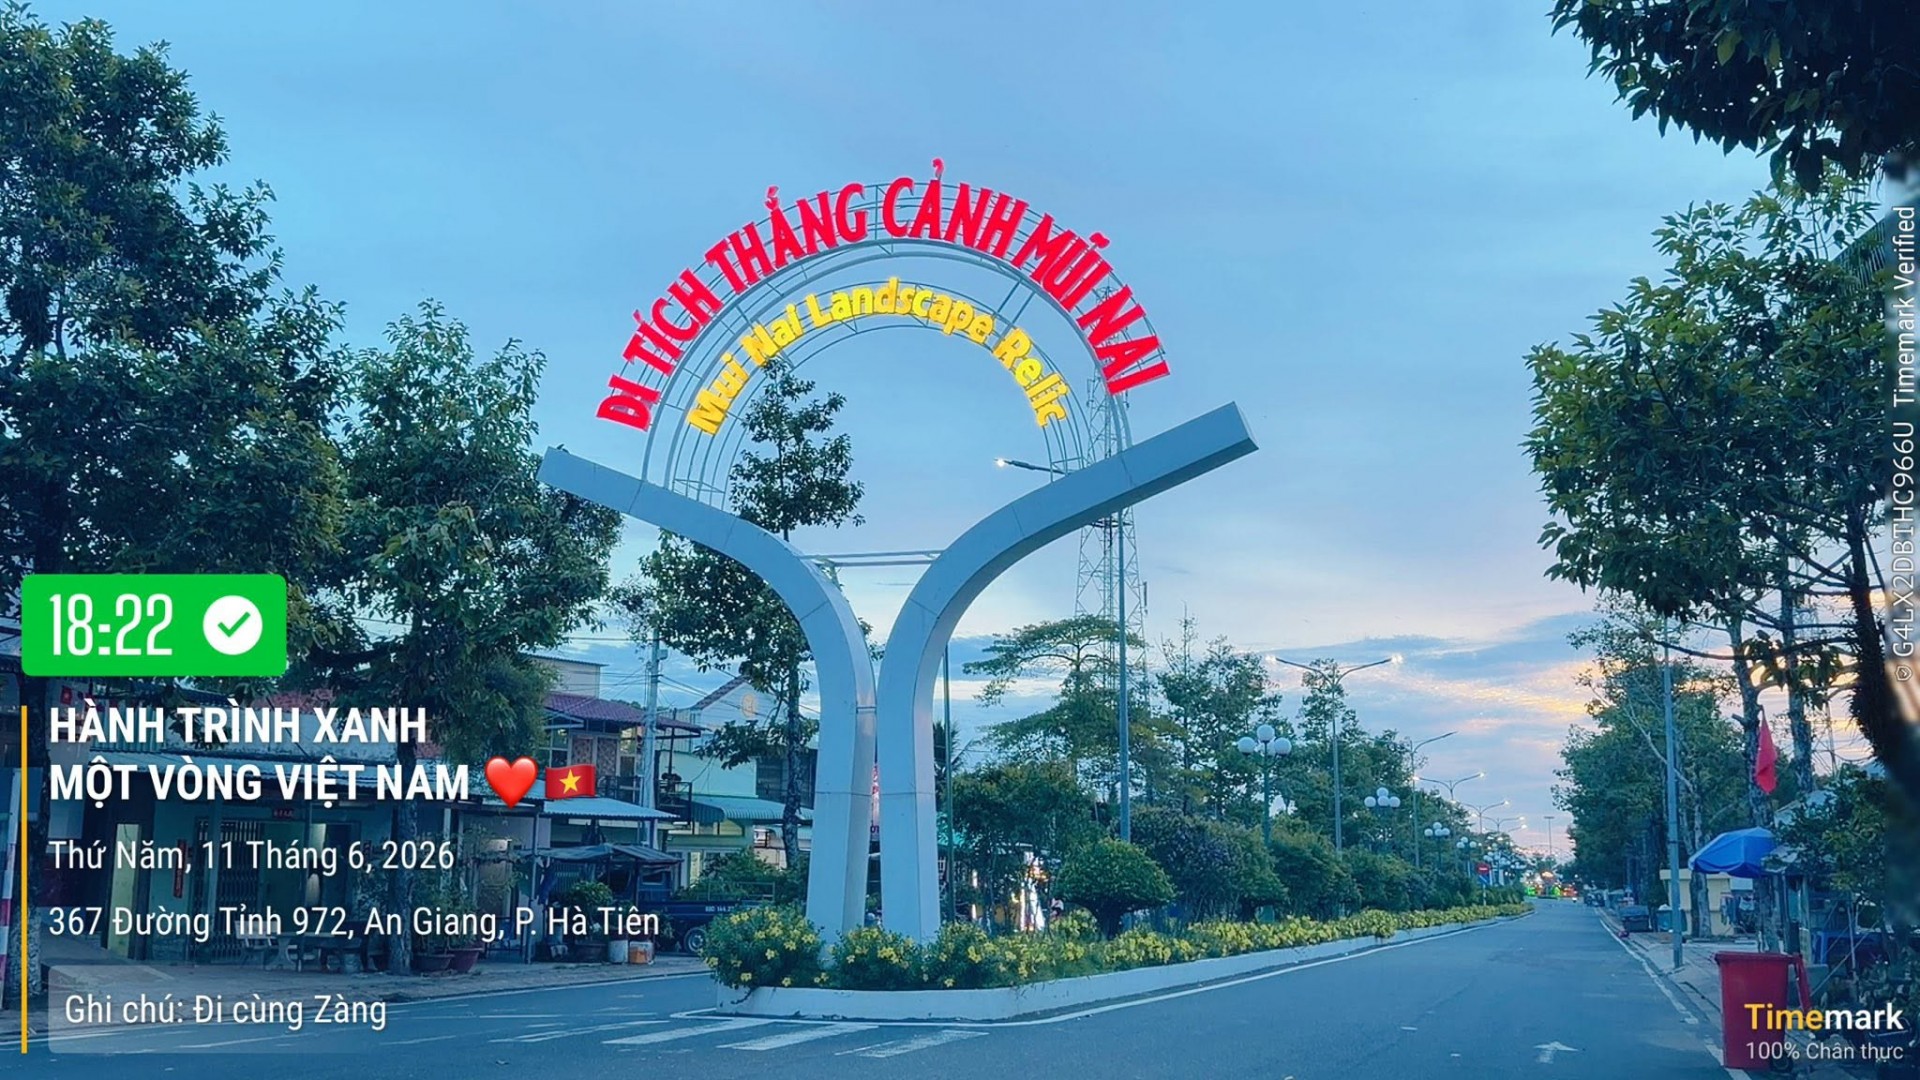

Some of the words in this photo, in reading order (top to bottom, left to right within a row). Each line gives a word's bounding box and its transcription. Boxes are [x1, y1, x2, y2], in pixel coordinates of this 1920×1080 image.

[704, 183, 868, 294] THẮNG
[881, 158, 1029, 270] CẢNH
[1010, 213, 1113, 312] MŨI
[622, 267, 724, 377] TÍCH
[686, 353, 750, 436] Mui
[740, 303, 805, 367] Nai
[804, 277, 996, 344] Landscape
[992, 327, 1070, 428] Relic
[1077, 285, 1171, 396] NAI
[596, 374, 661, 432] DI
